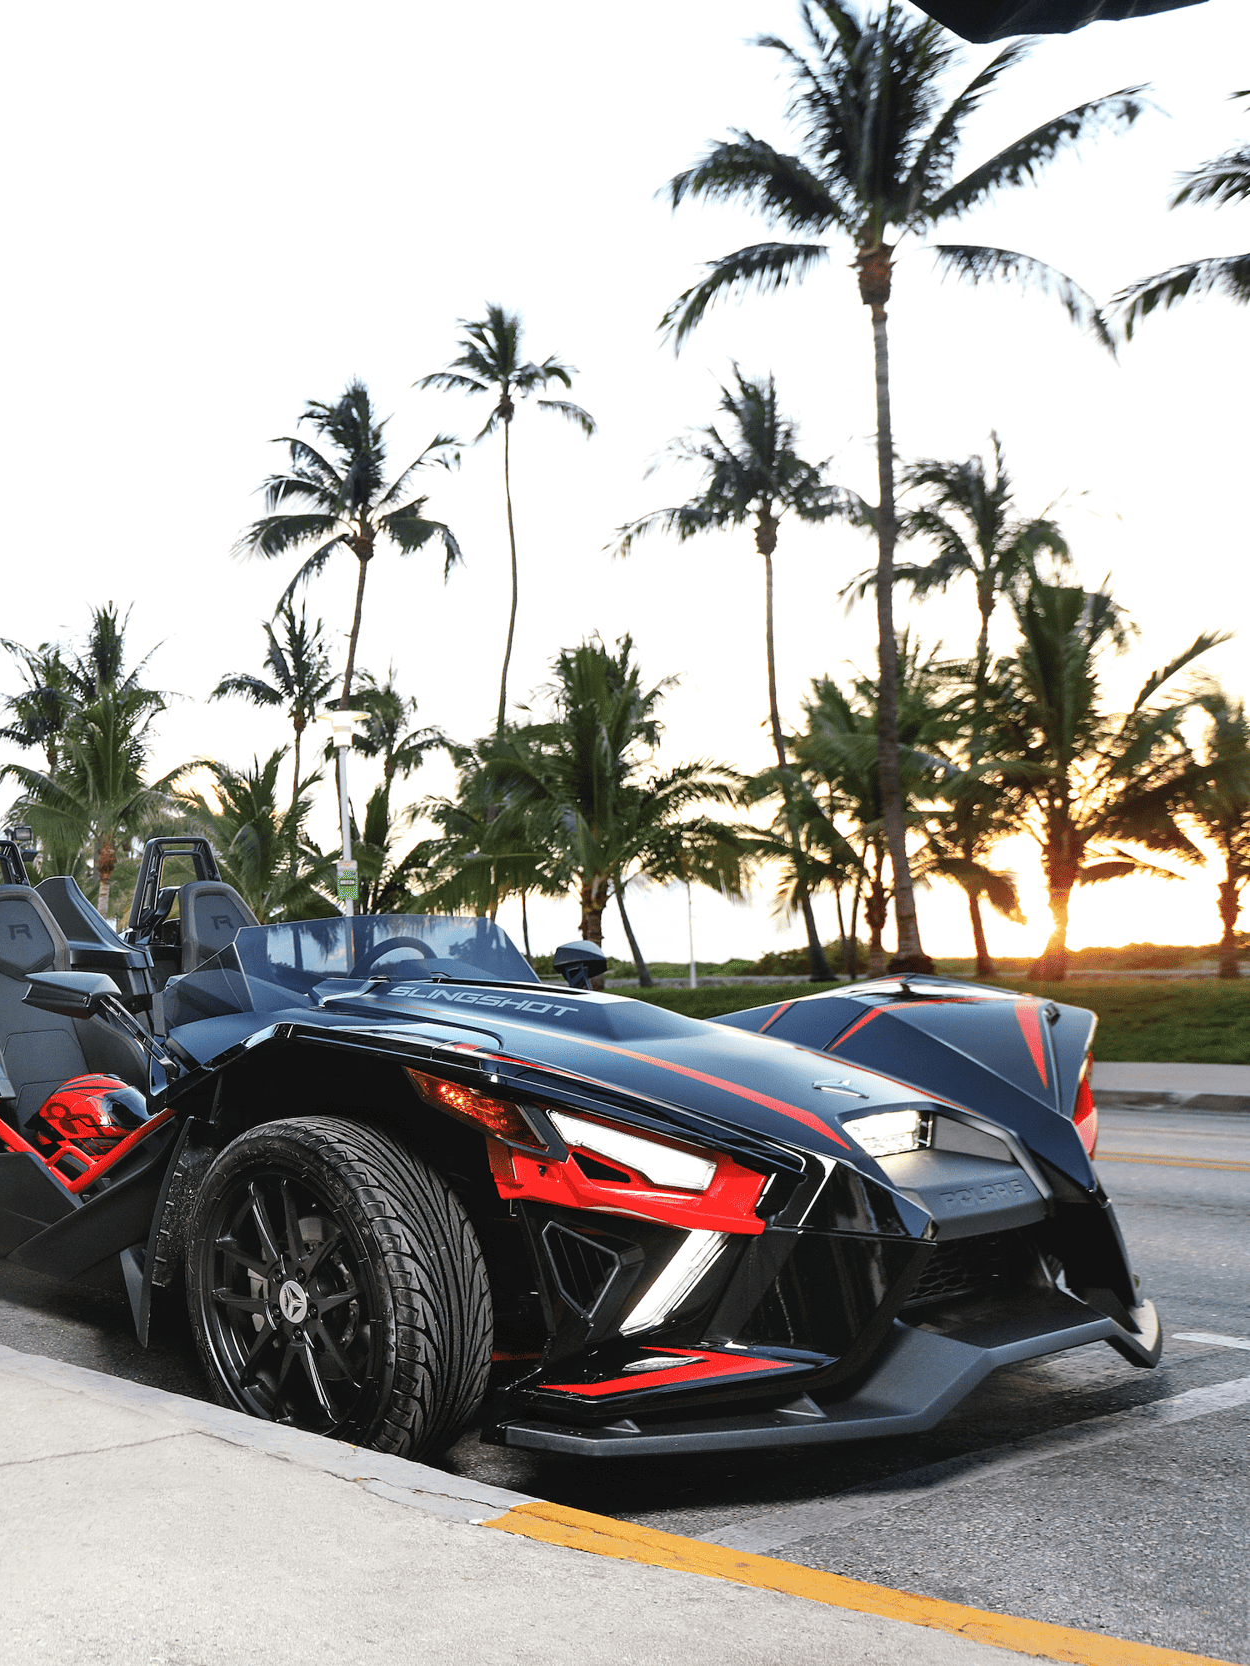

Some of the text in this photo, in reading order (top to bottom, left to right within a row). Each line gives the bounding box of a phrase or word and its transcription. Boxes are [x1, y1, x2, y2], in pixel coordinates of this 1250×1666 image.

[7, 923, 33, 940] R
[210, 914, 234, 931] R
[386, 985, 579, 1017] SLINGSHOT
[939, 1179, 1025, 1207] POLARIS
